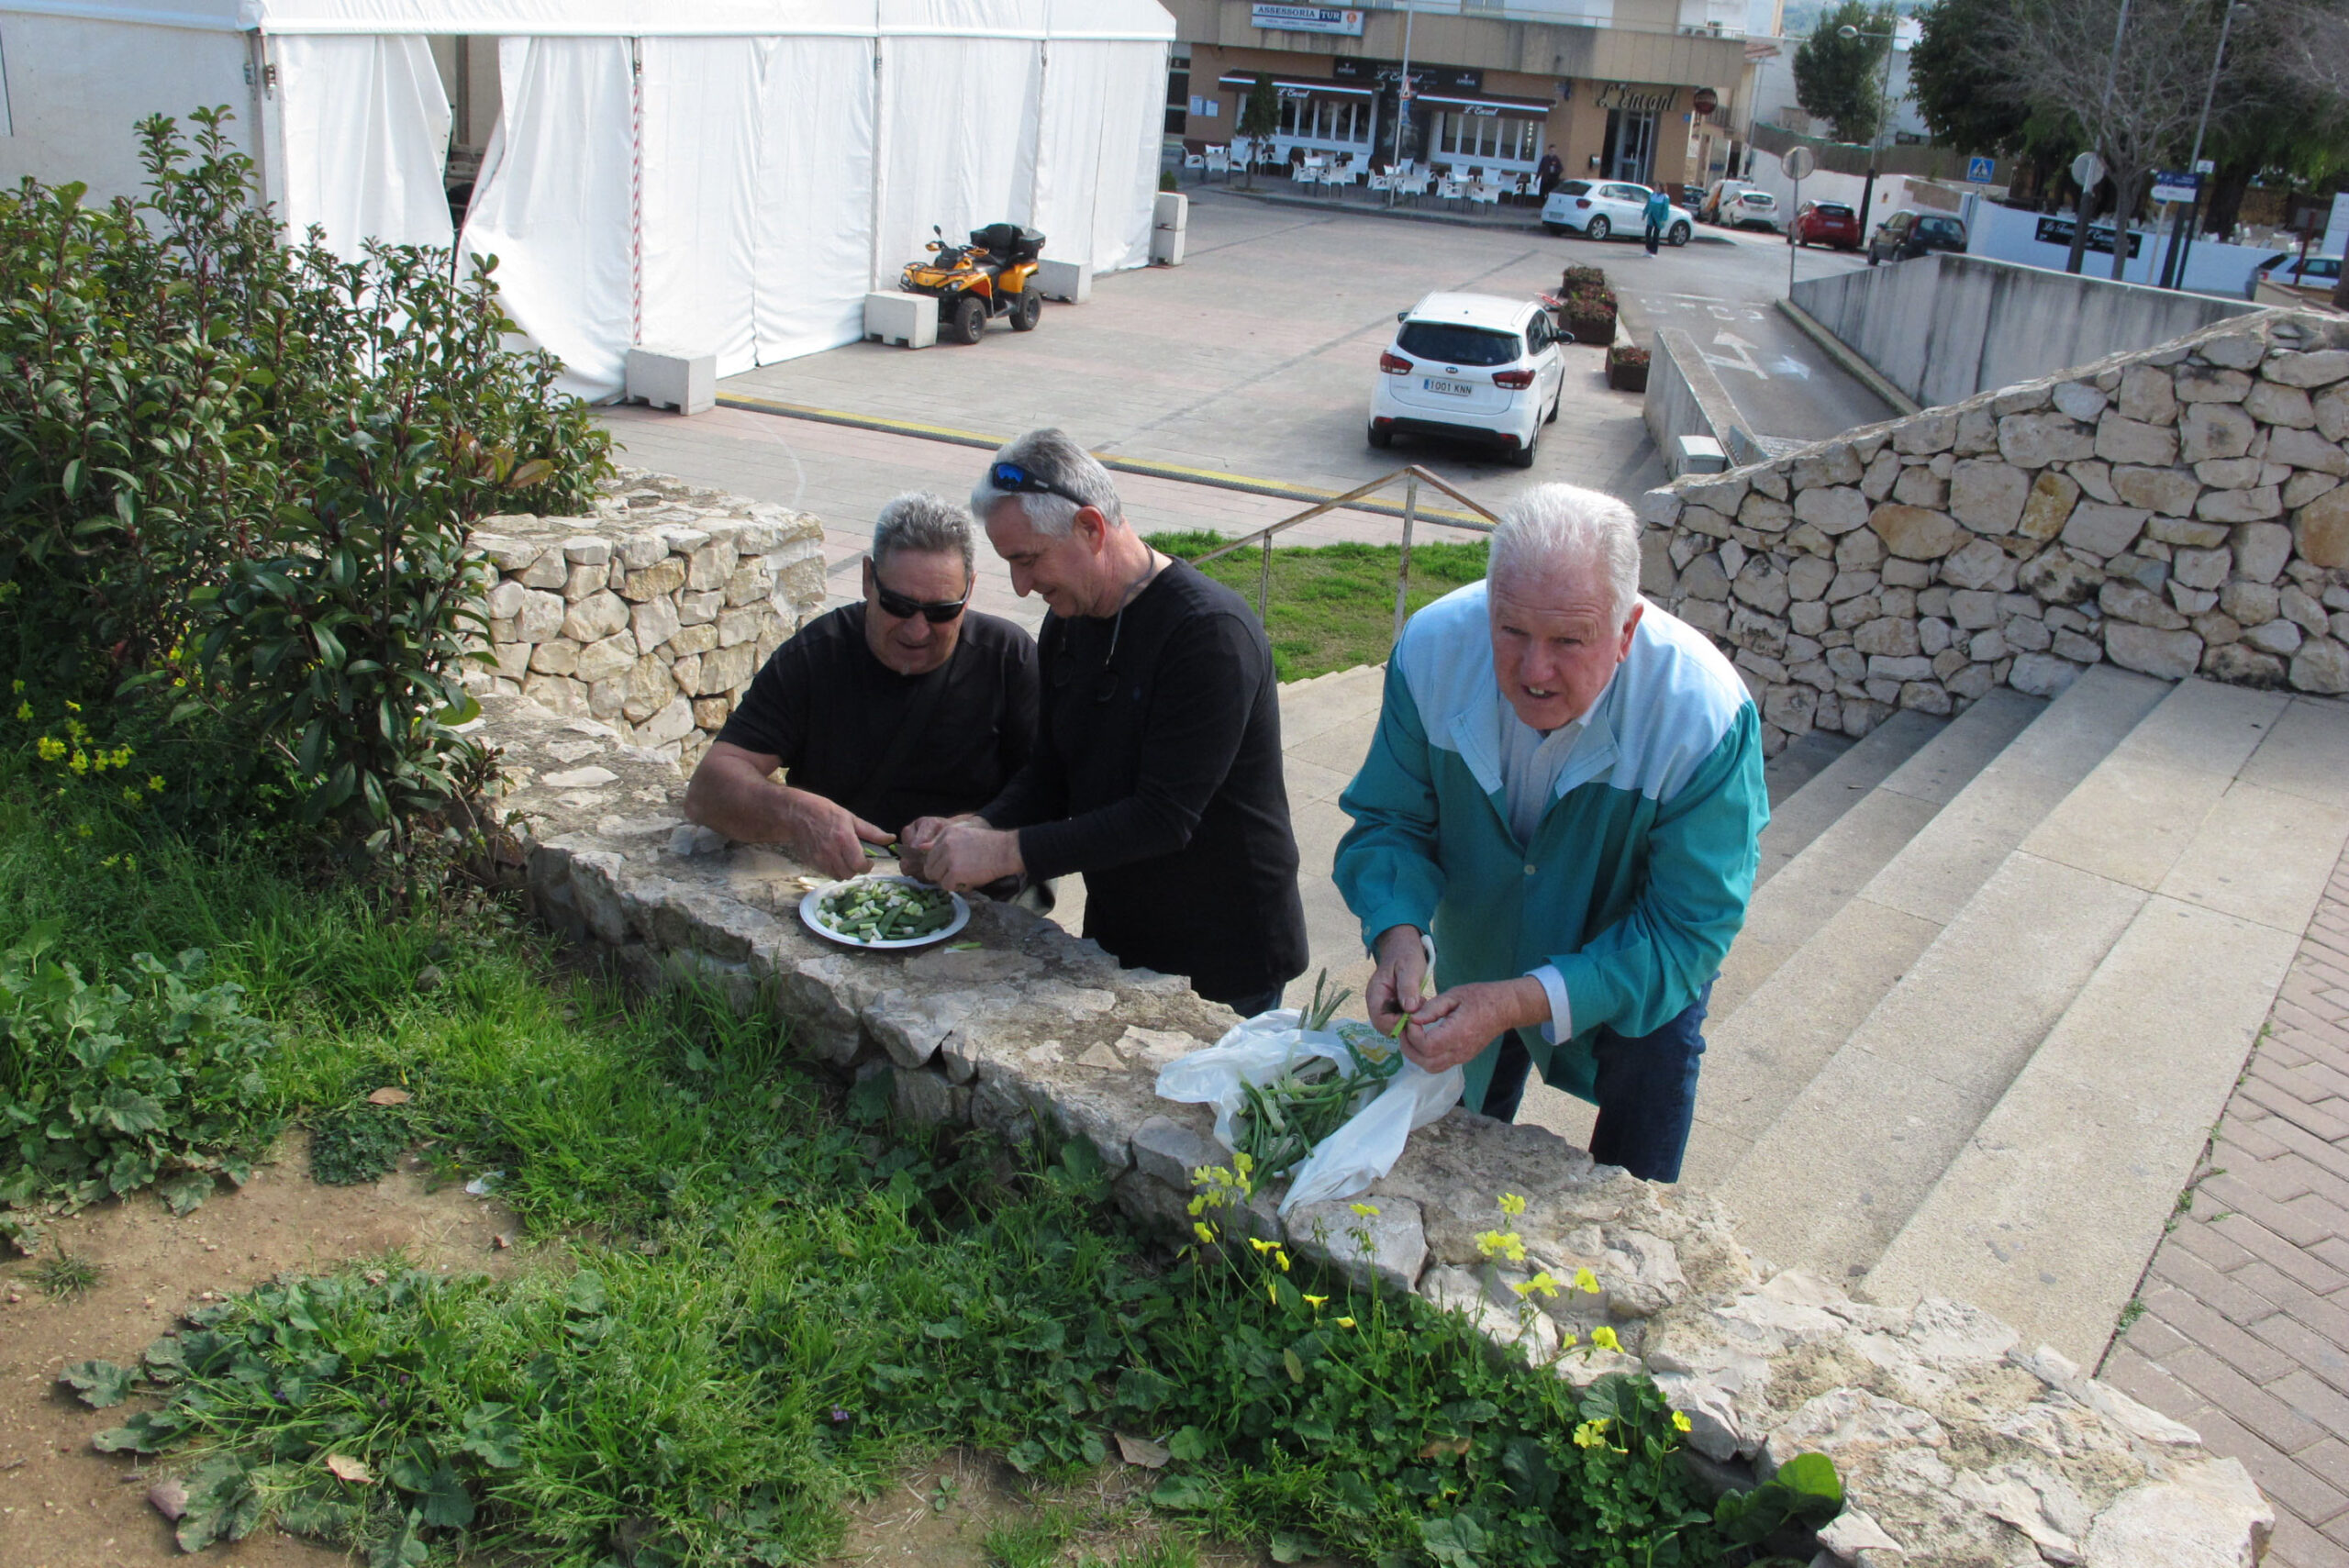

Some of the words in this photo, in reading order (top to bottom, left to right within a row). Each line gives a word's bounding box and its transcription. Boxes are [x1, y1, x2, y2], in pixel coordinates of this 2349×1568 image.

[1258, 6, 1316, 17] ASSESSORIA
[1320, 10, 1341, 21] TUR
[1431, 381, 1451, 392] 1001
[1454, 384, 1472, 395] KNN
